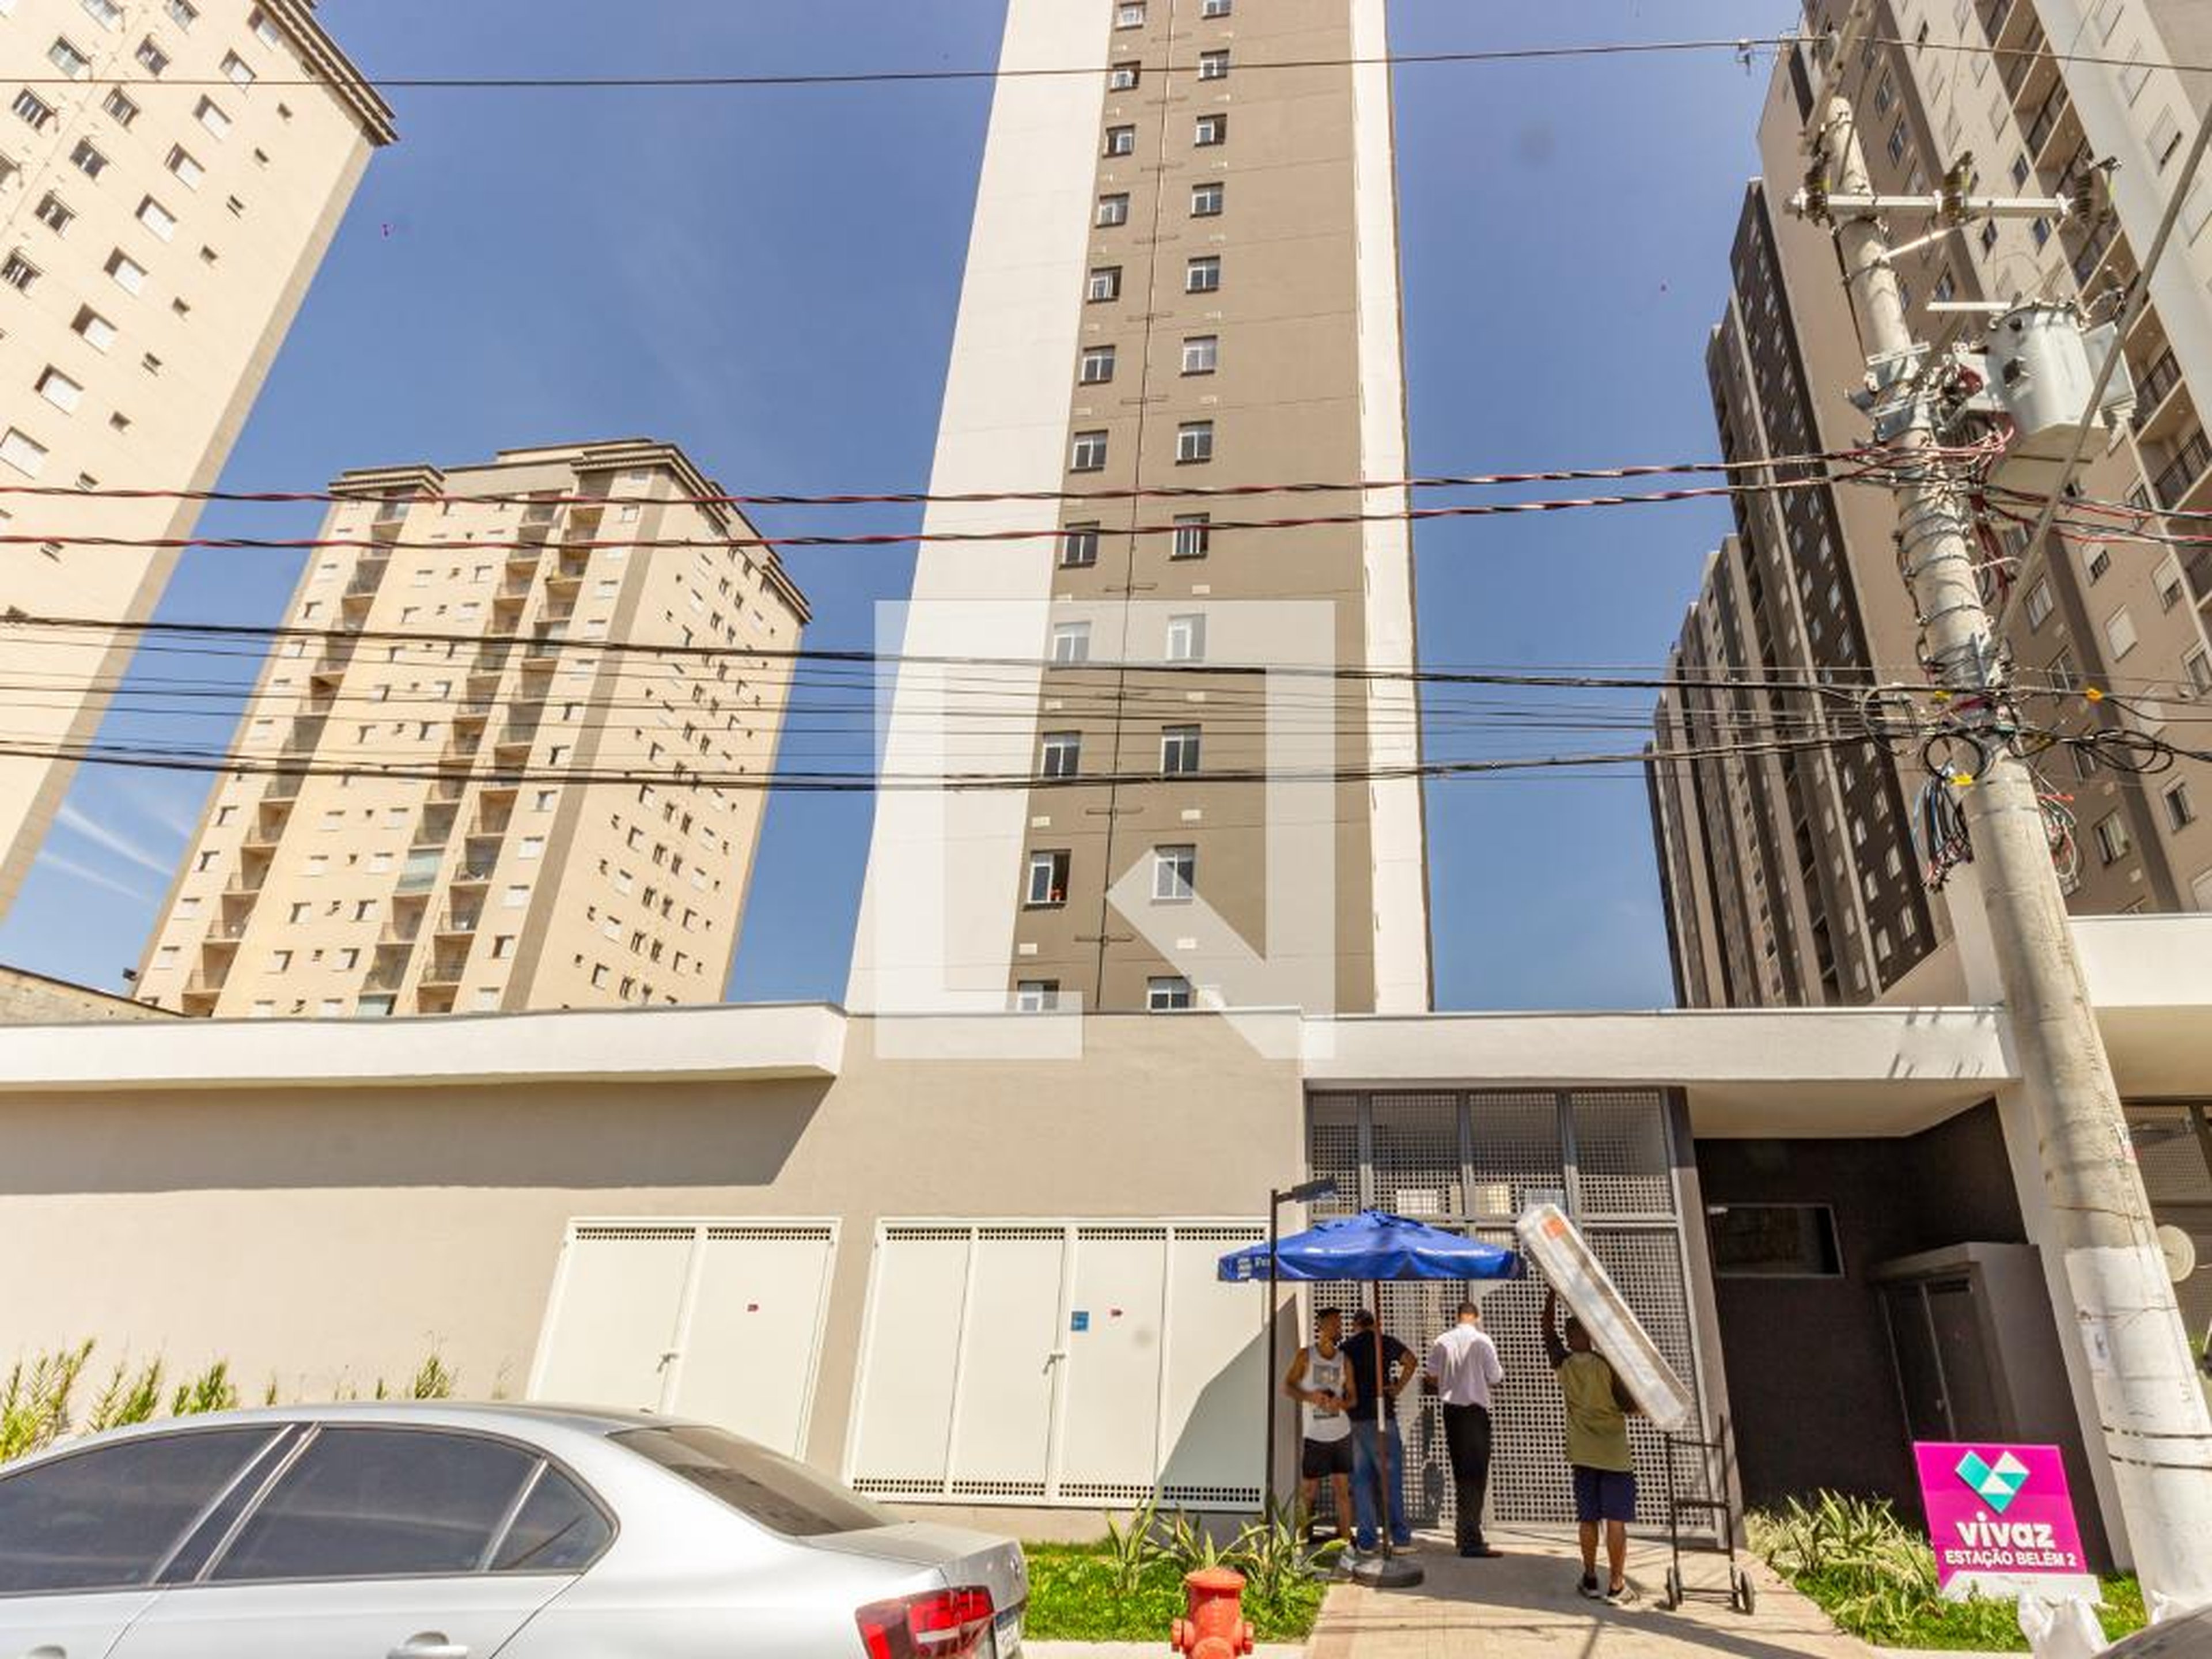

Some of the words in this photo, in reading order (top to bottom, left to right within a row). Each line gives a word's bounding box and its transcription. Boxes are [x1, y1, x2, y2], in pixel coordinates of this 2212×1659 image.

[1956, 1512, 2055, 1548] vivaz
[1945, 1548, 2013, 1568] ESTAÇÃO
[2016, 1550, 2065, 1566] BELÉM
[2066, 1553, 2077, 1567] 2
